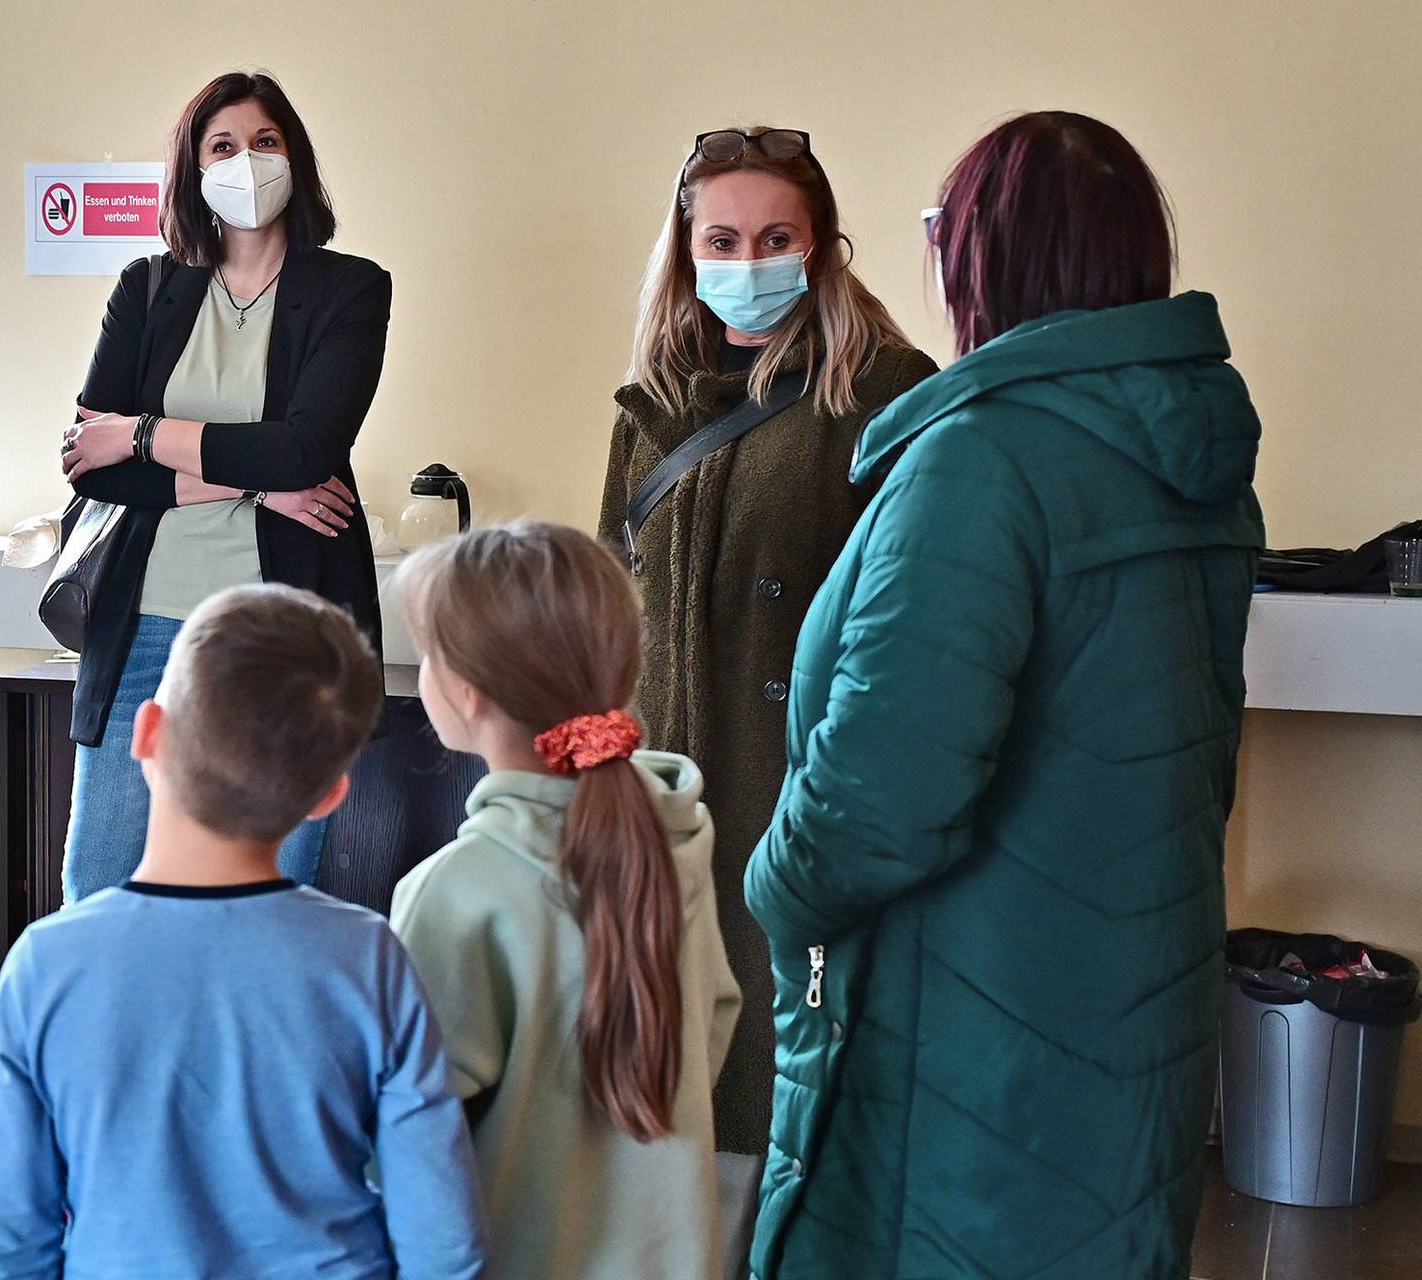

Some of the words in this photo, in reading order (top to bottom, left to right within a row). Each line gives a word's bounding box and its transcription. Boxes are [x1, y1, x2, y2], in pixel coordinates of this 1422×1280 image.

[85, 195, 109, 206] Essen
[111, 195, 126, 206] und
[128, 195, 156, 206] Trinken
[104, 211, 139, 222] verboten
